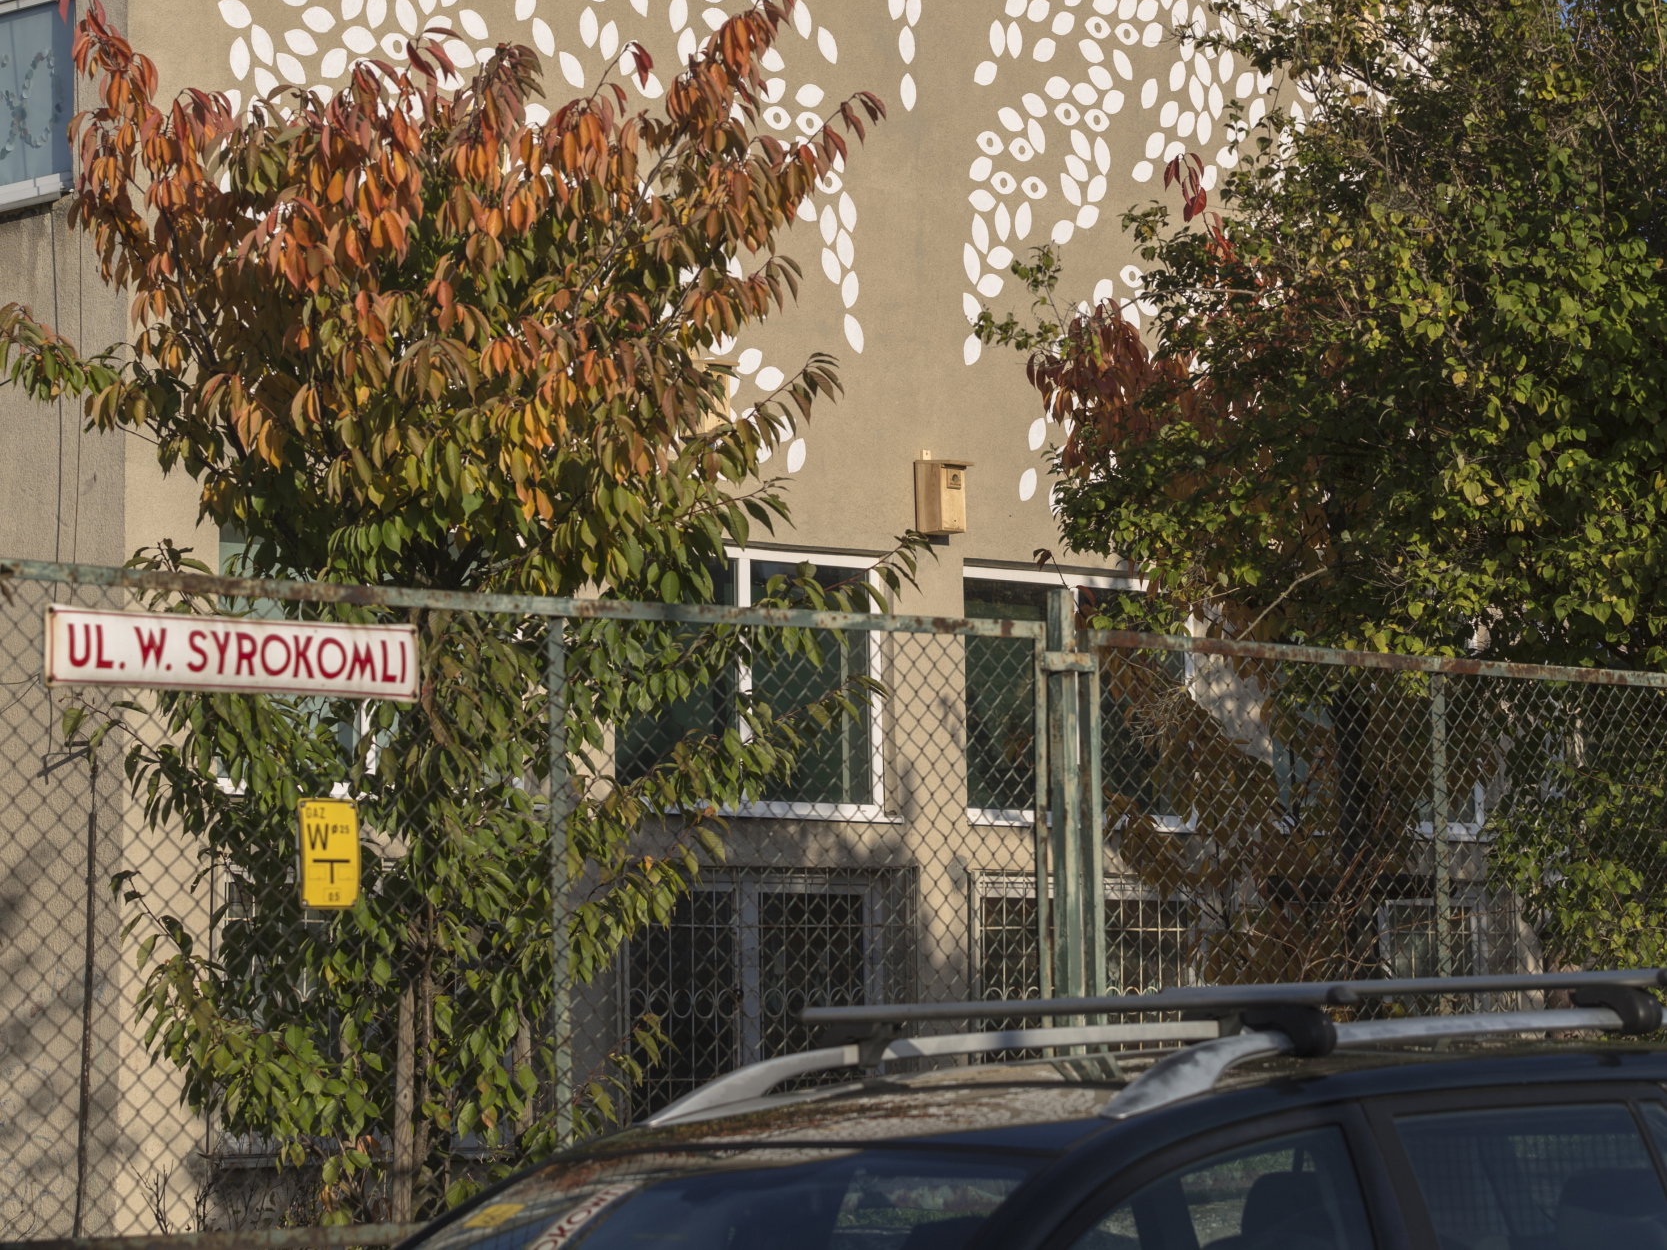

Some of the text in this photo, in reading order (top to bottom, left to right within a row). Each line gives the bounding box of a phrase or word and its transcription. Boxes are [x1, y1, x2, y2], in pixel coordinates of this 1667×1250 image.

[68, 624, 407, 683] UL. W. SYROKOMLI
[306, 823, 329, 851] W
